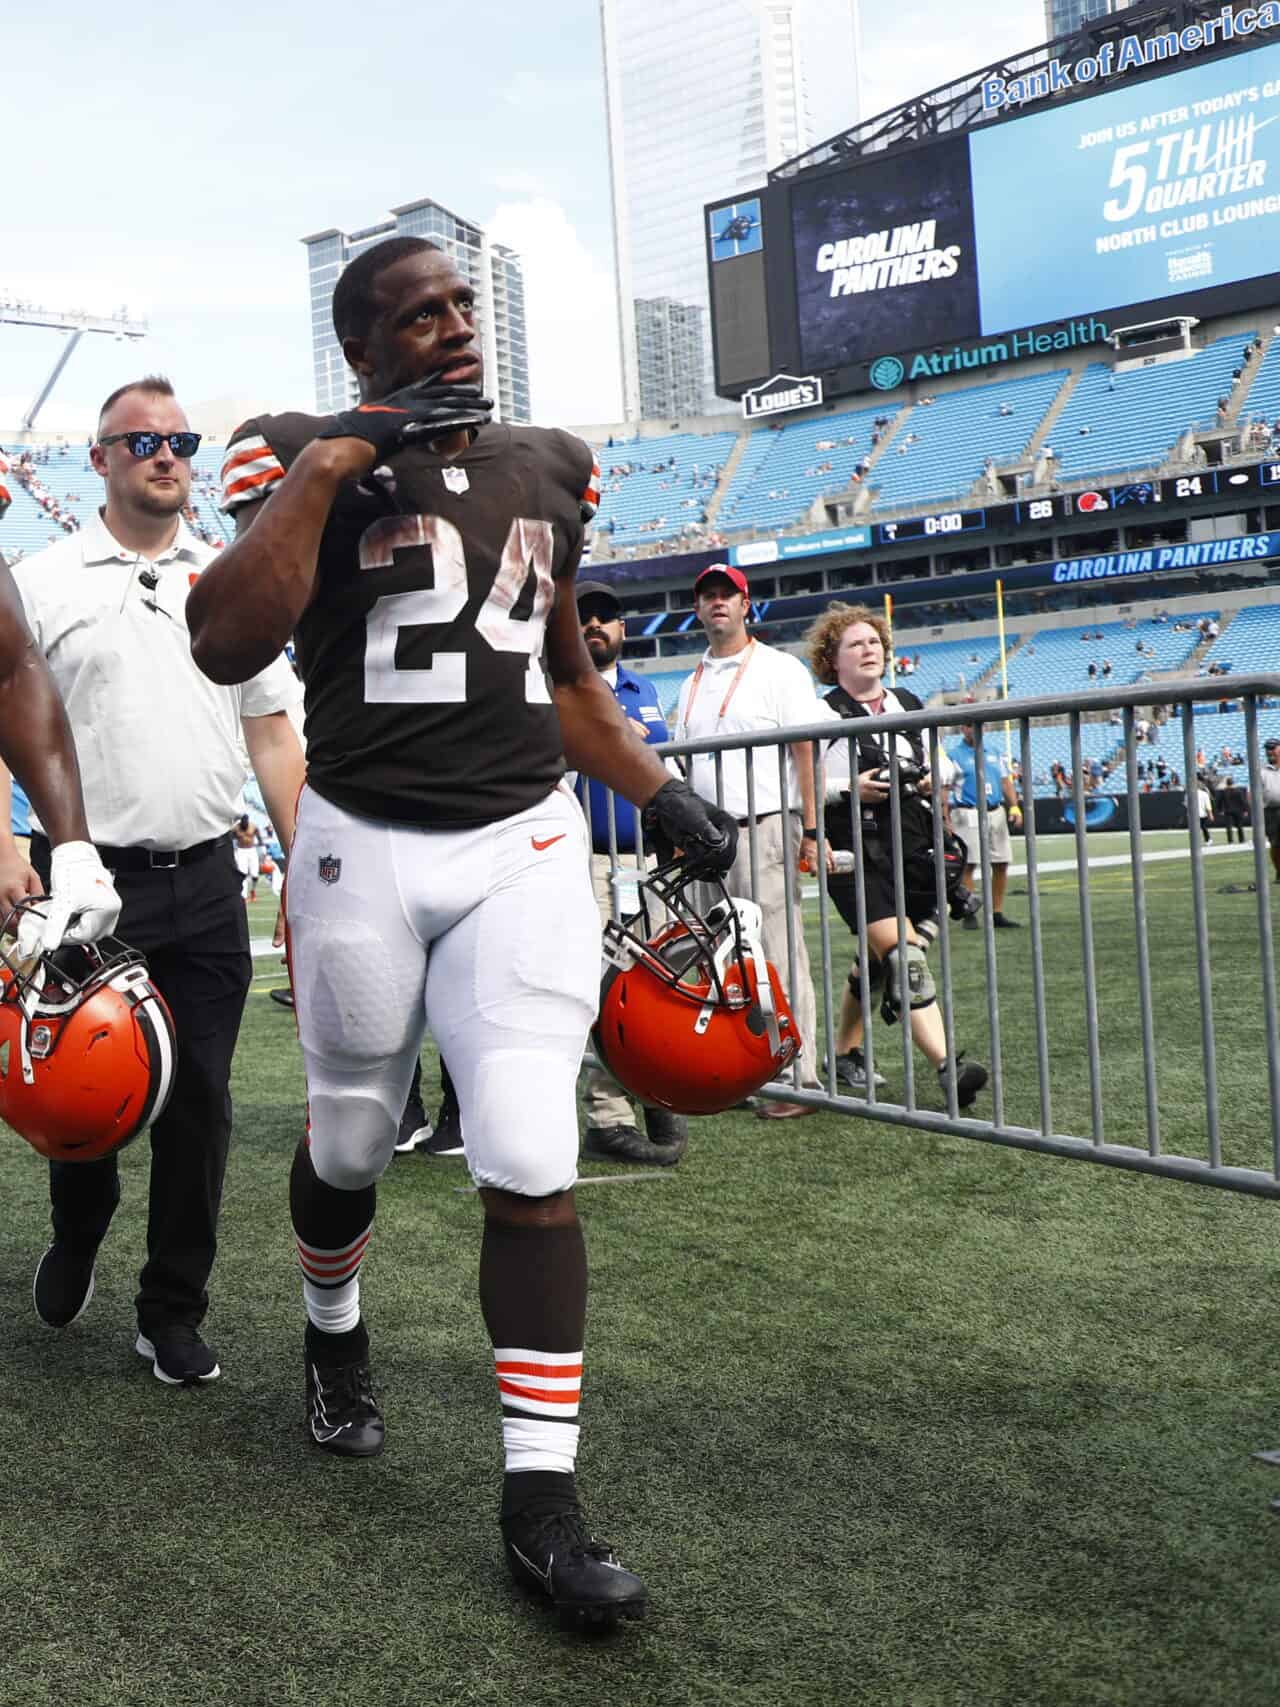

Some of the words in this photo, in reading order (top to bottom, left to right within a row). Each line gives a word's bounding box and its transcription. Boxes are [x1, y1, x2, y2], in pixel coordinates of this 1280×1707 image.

[982, 59, 1072, 111] Bank
[1074, 42, 1114, 83] of
[1117, 1, 1280, 72] America
[1077, 127, 1113, 149] JOIN
[1116, 121, 1137, 137] US
[1140, 106, 1189, 132] AFTER
[1192, 86, 1259, 118] TODAY'S
[1145, 160, 1267, 214] QUARTER
[816, 219, 937, 272] CAROLINA
[1096, 225, 1157, 254] NORTH
[1160, 212, 1208, 238] CLUB
[830, 245, 960, 298] PANTHERS
[909, 342, 1008, 379] Atrium
[1011, 318, 1107, 358] Health
[750, 385, 814, 413] LOWE'S
[1029, 500, 1053, 519] 26
[1176, 477, 1202, 497] 24
[925, 514, 962, 535] 0:00
[1053, 553, 1153, 583] CAROLINA
[1158, 535, 1270, 569] PANTHERS
[359, 514, 555, 704] 24
